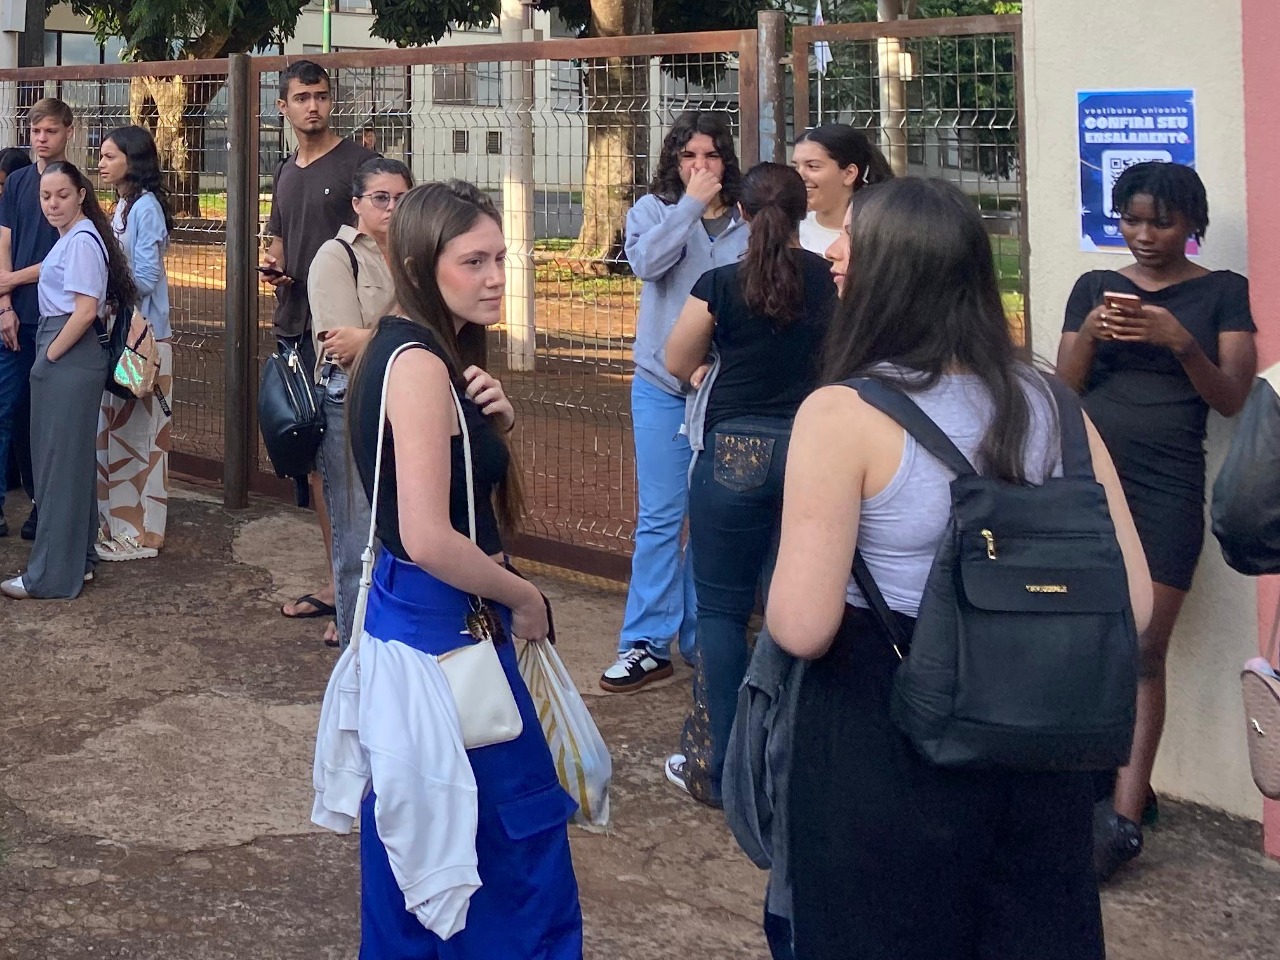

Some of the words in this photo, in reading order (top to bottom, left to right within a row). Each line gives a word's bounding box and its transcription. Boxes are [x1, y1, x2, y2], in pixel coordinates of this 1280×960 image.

[1084, 106, 1138, 115] vestibular
[1141, 106, 1188, 114] unioeste
[1084, 116, 1156, 130] CONFIRA
[1157, 116, 1189, 130] SEU
